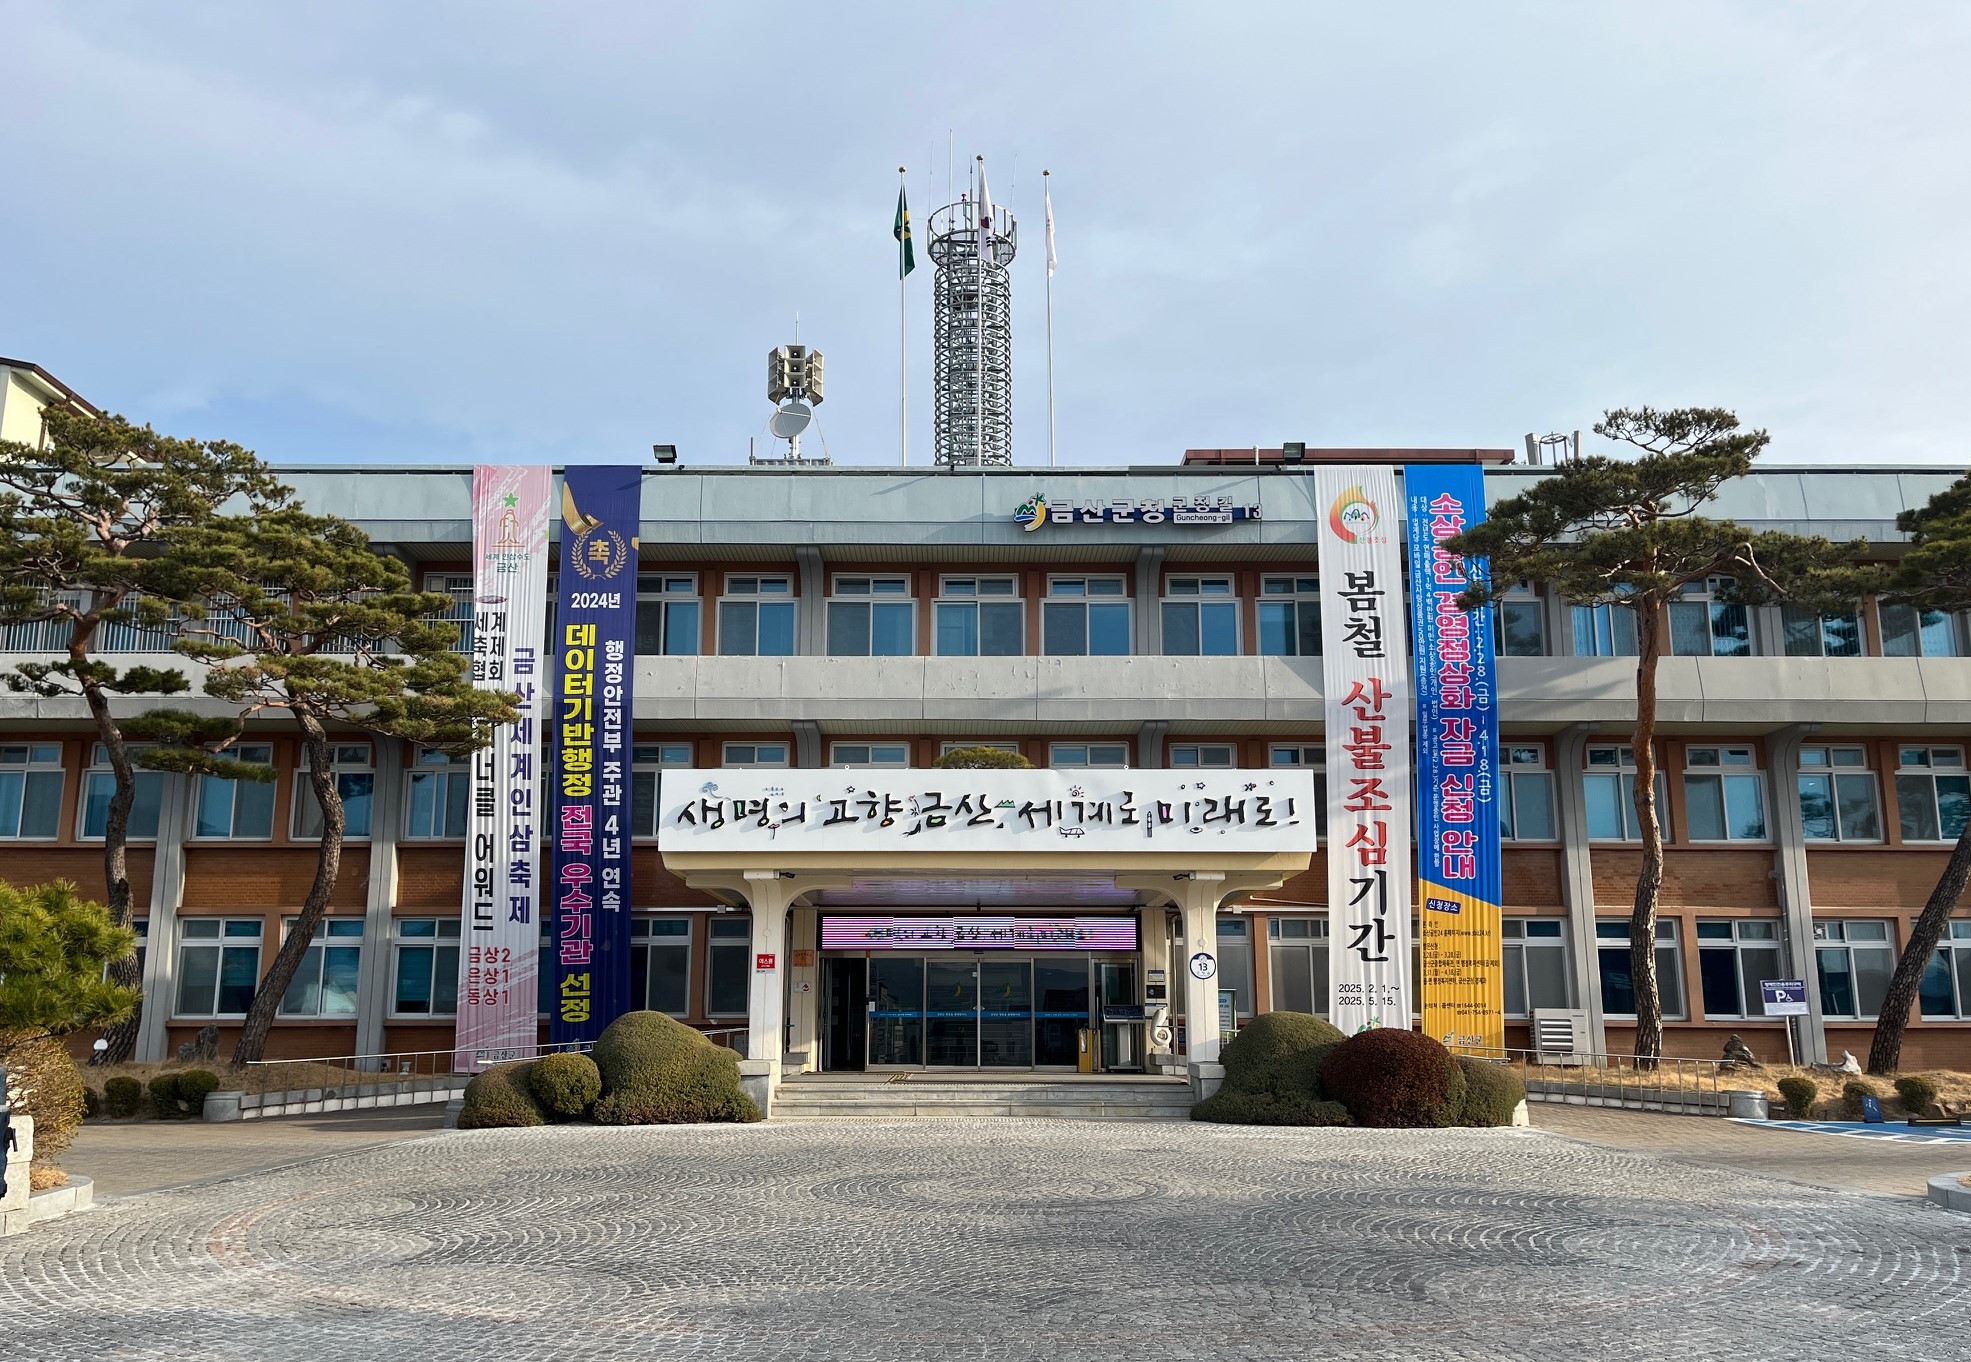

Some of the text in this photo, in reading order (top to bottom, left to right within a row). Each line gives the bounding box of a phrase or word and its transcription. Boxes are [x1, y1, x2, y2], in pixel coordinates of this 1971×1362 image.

[1051, 498, 1165, 524] 금산군청
[1172, 495, 1263, 519] 군청길 13
[1420, 496, 1428, 512] 대상
[1176, 514, 1231, 523] Guncheong-gil
[587, 539, 610, 565] 축
[497, 562, 518, 573] 금산
[571, 592, 621, 609] 2024년
[1337, 570, 1386, 659] 봄철
[1439, 717, 1477, 767] 자금
[601, 640, 624, 913] 행정안전부 주관 4년 연속
[677, 797, 806, 829] 생명의
[921, 792, 995, 827] 금산
[1018, 790, 1140, 828] 세계로
[1440, 773, 1476, 823] 신청
[559, 624, 596, 1023] 데이터기반행정 전국 우수기관 선정
[1441, 829, 1478, 879] 안내
[473, 833, 494, 931] 어워드
[1428, 899, 1458, 912] 신청장소
[1197, 962, 1208, 971] 13
[1338, 983, 1364, 993] 2025.
[1368, 983, 1377, 993] 2.
[1775, 990, 1786, 1003] P
[1338, 996, 1396, 1006] 2025. 5. 15.
